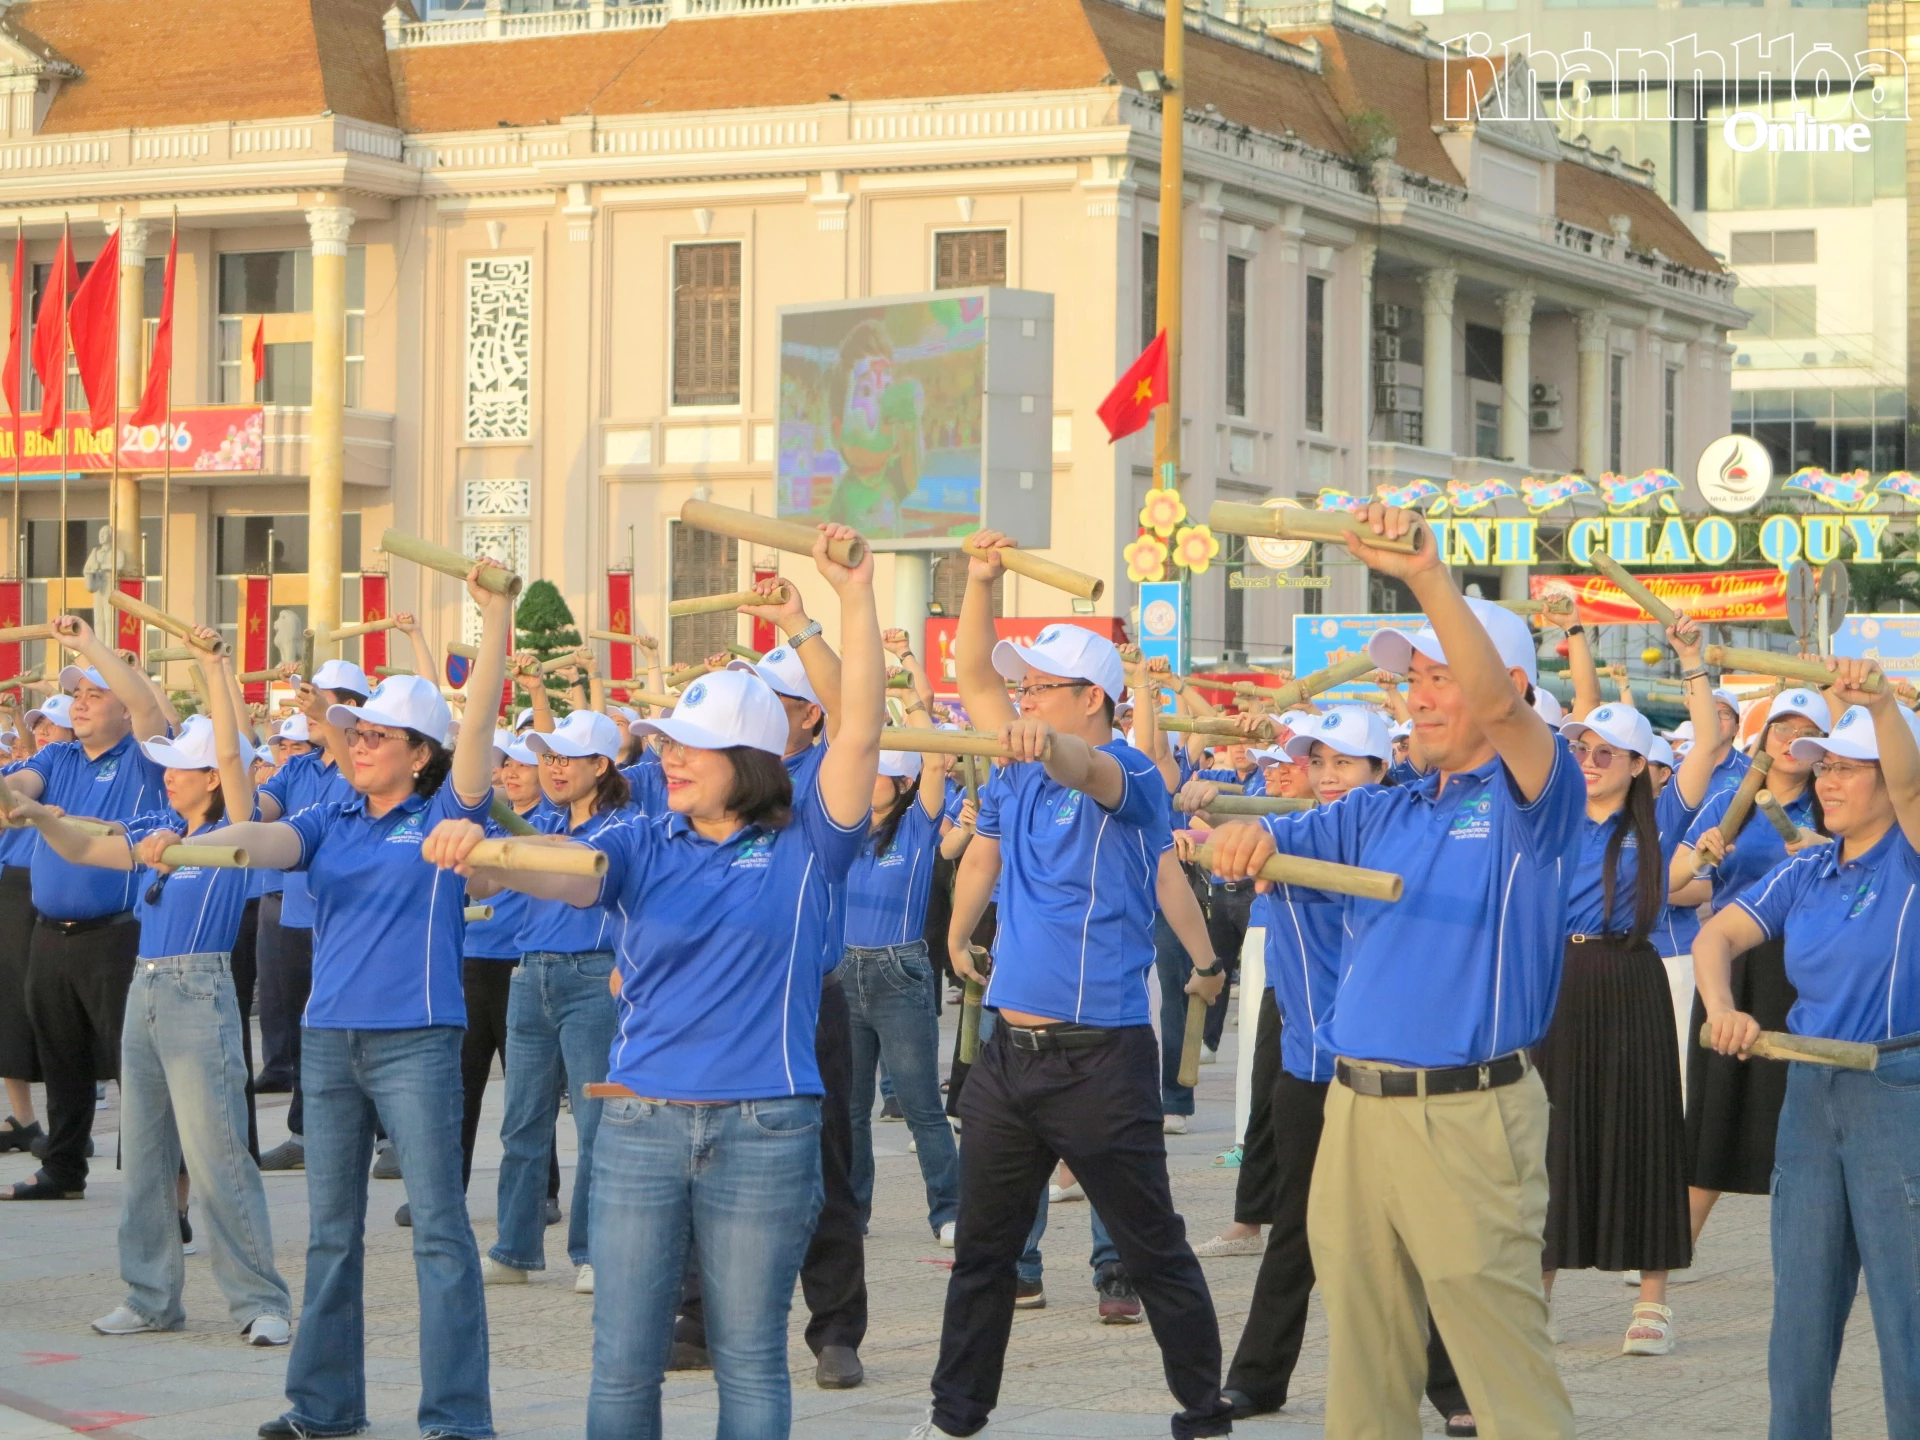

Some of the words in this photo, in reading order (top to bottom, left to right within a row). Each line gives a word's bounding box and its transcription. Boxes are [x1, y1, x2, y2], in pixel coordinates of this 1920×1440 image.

[120, 421, 192, 453] 2026
[1425, 495, 1539, 566] ÍNH
[1567, 494, 1737, 567] CHÀO
[1759, 491, 1890, 576] QUÝ
[1711, 573, 1767, 597] Năm
[1725, 602, 1766, 617] 2026
